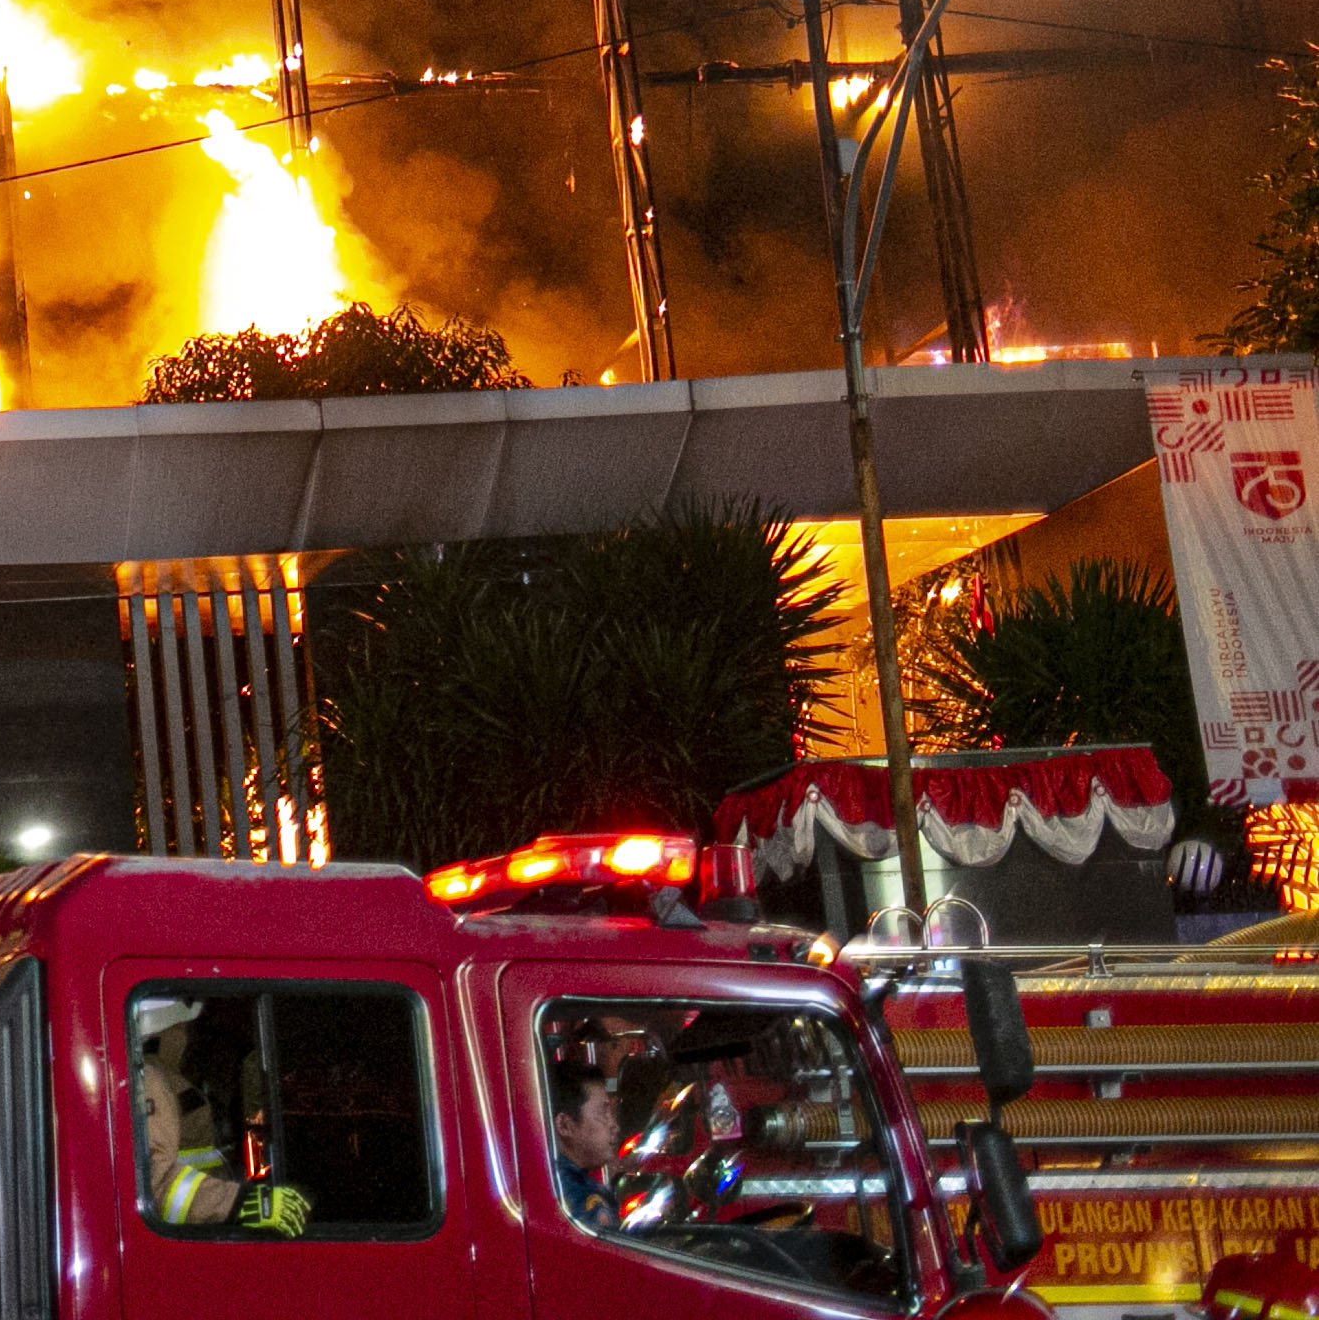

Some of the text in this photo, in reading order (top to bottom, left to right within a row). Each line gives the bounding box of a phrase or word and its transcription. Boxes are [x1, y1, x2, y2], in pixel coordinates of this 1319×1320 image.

[1243, 526, 1314, 536] INDONESIA
[1224, 589, 1248, 678] INDONESIA
[1161, 1197, 1305, 1230] KEBAKARAN
